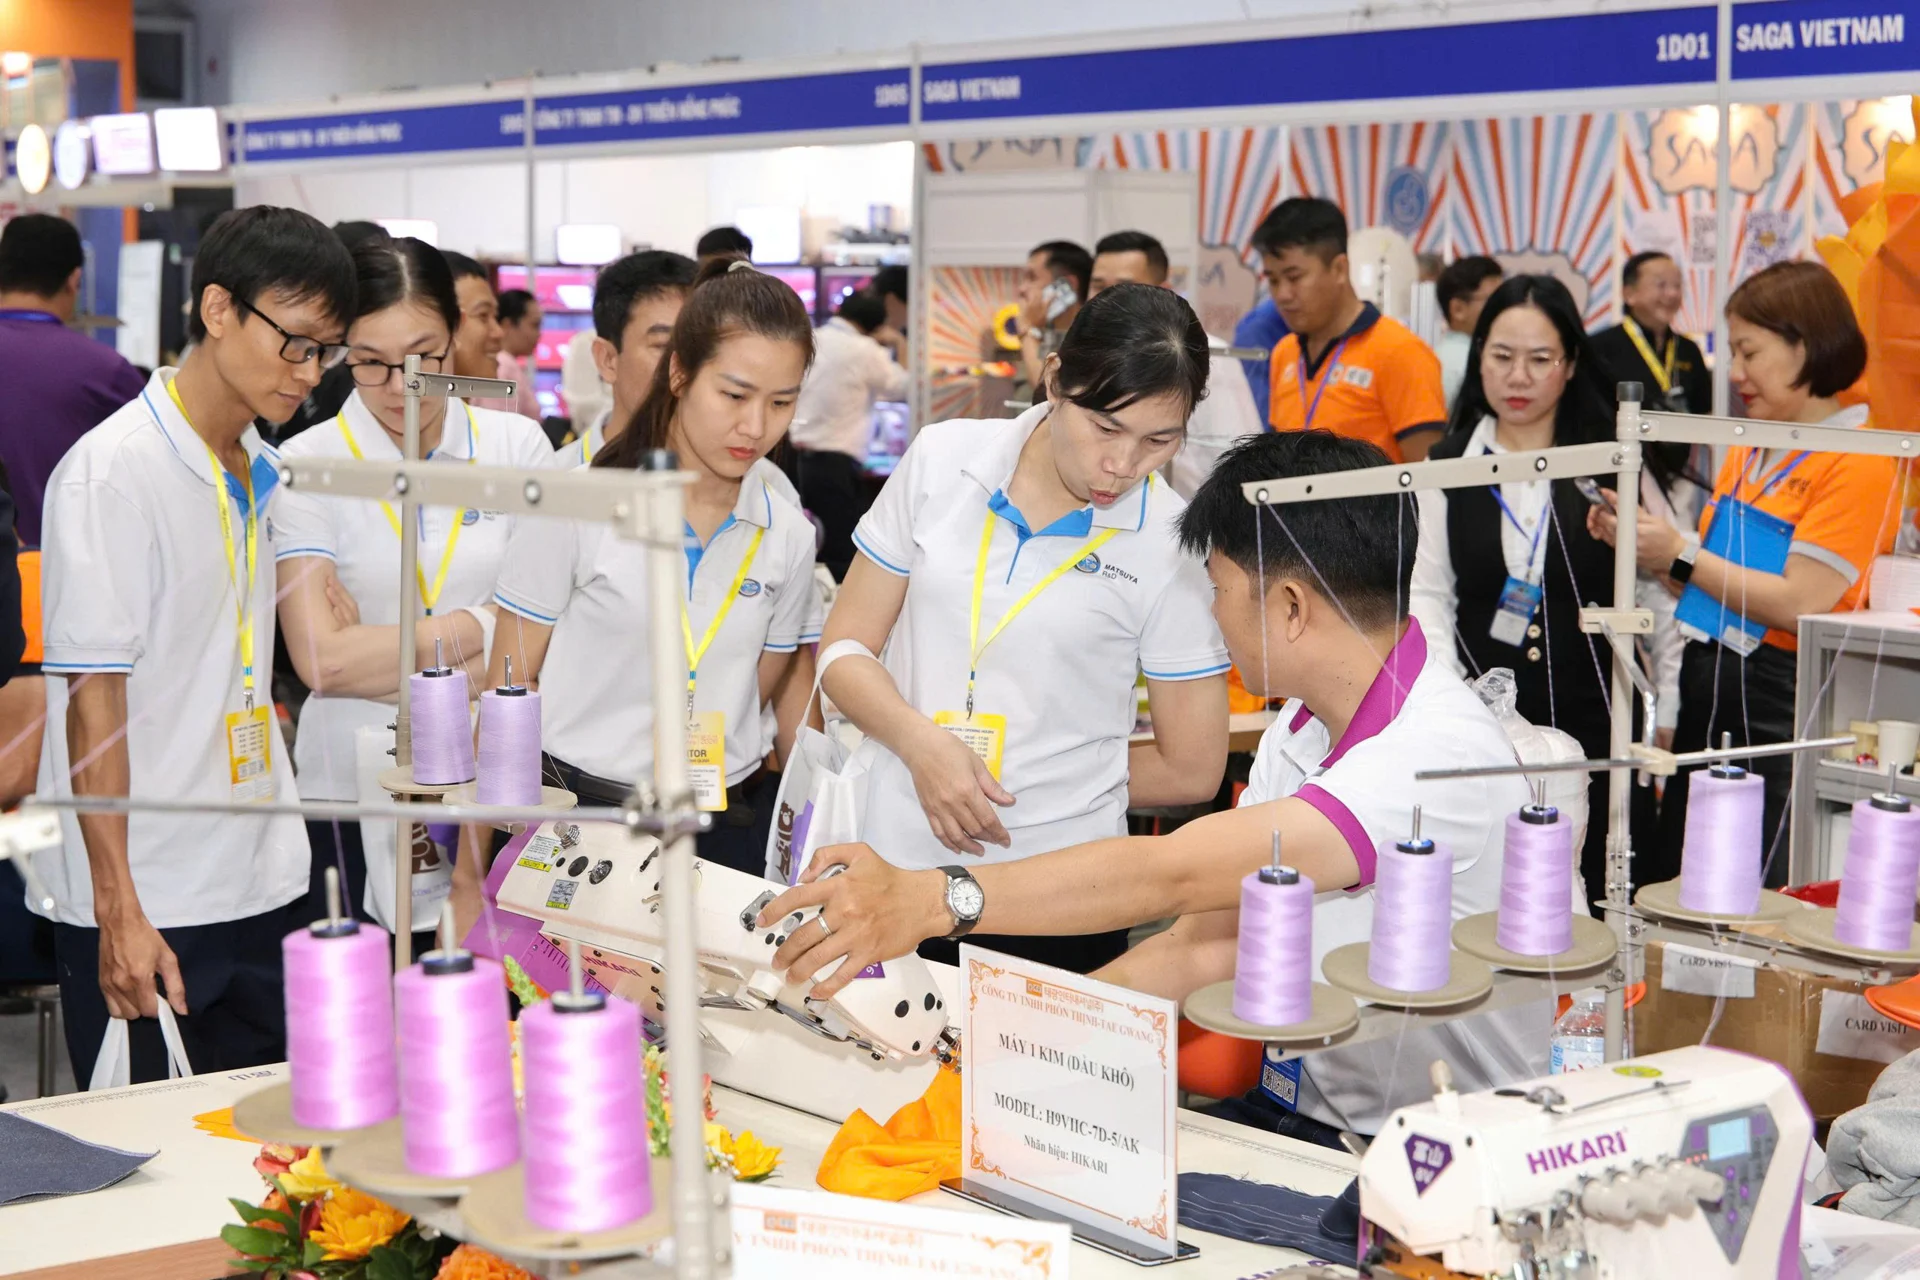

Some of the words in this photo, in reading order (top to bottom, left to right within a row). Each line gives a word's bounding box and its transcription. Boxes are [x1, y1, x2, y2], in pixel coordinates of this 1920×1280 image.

[1656, 33, 1710, 61] 1D01
[1736, 21, 1795, 52] SAGA
[1801, 14, 1904, 48] VIETNAM
[1102, 570, 1117, 580] R&D
[1104, 564, 1138, 584] MATSUYA
[1006, 990, 1018, 1004] TY
[1119, 1021, 1154, 1044] GWANG
[1845, 1017, 1878, 1033] CARD
[999, 1033, 1027, 1054] MÁY
[1039, 1046, 1064, 1067] KIM
[1101, 1064, 1135, 1091] KHÔ)
[994, 1092, 1043, 1121] MODEL:
[1024, 1134, 1046, 1153] Nhãn
[1048, 1143, 1069, 1162] hiệu:
[1071, 1151, 1108, 1174] HIKARI
[1526, 1131, 1628, 1175] HIKARI
